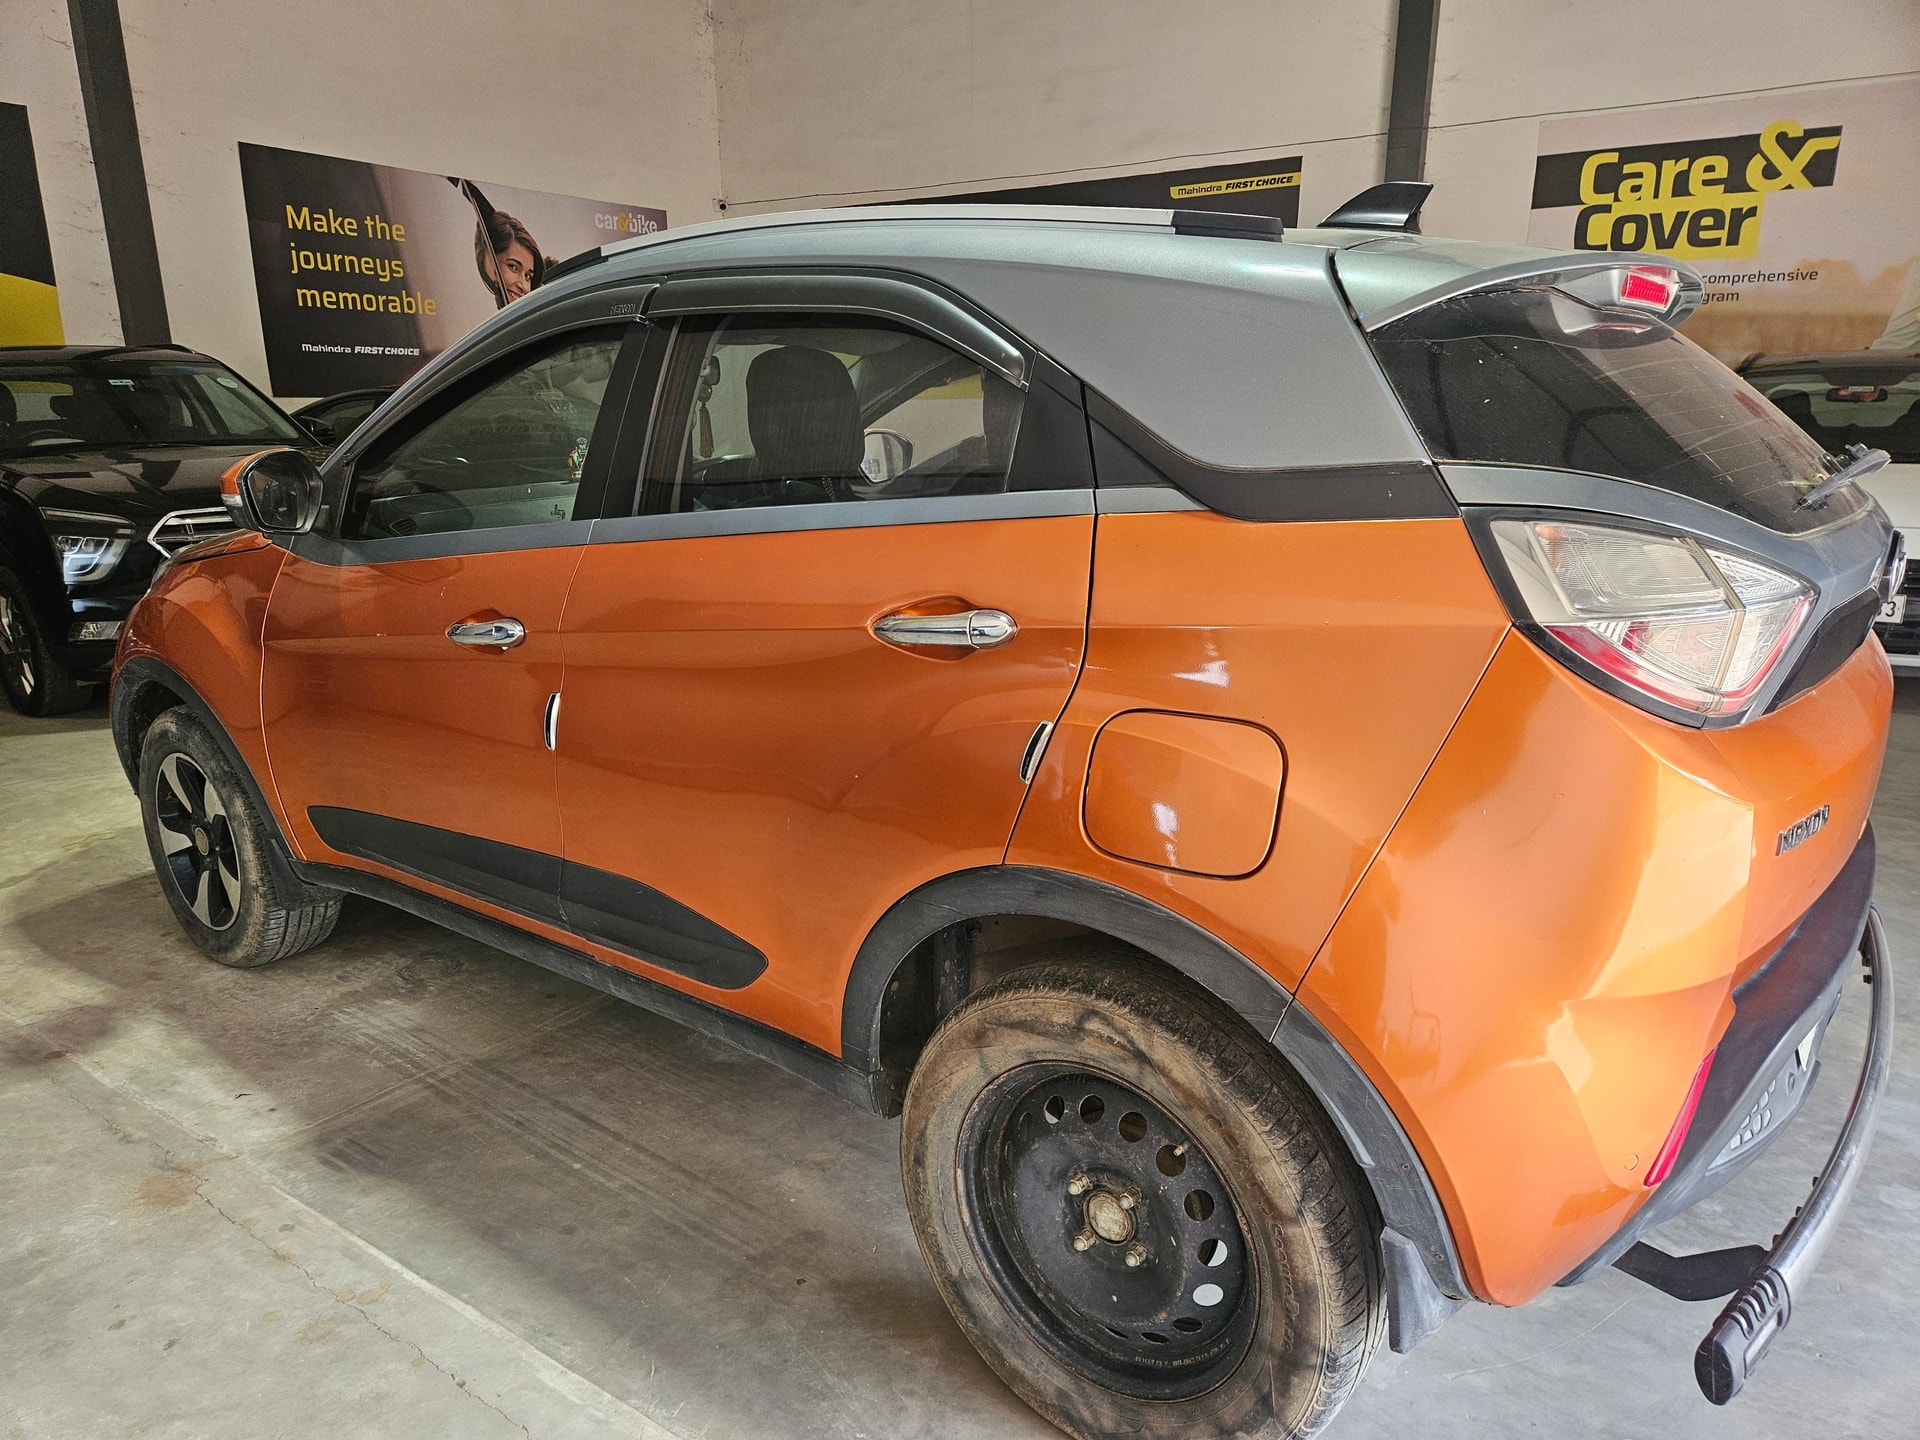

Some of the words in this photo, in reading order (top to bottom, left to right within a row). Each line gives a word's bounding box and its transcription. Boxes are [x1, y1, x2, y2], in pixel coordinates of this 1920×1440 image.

[1579, 151, 1729, 205] Care
[1746, 119, 1842, 192] &
[1177, 185, 1222, 196] Mahindra
[1225, 180, 1255, 191] FIRST
[1256, 176, 1294, 187] CHOICE
[285, 204, 358, 237] Make
[364, 214, 406, 242] the
[1573, 204, 1759, 251] Cover
[290, 242, 404, 282] journeys
[296, 288, 437, 316] memorable
[301, 343, 352, 354] Mahindra
[354, 345, 384, 354] FIRST
[384, 347, 420, 356] CHOICE
